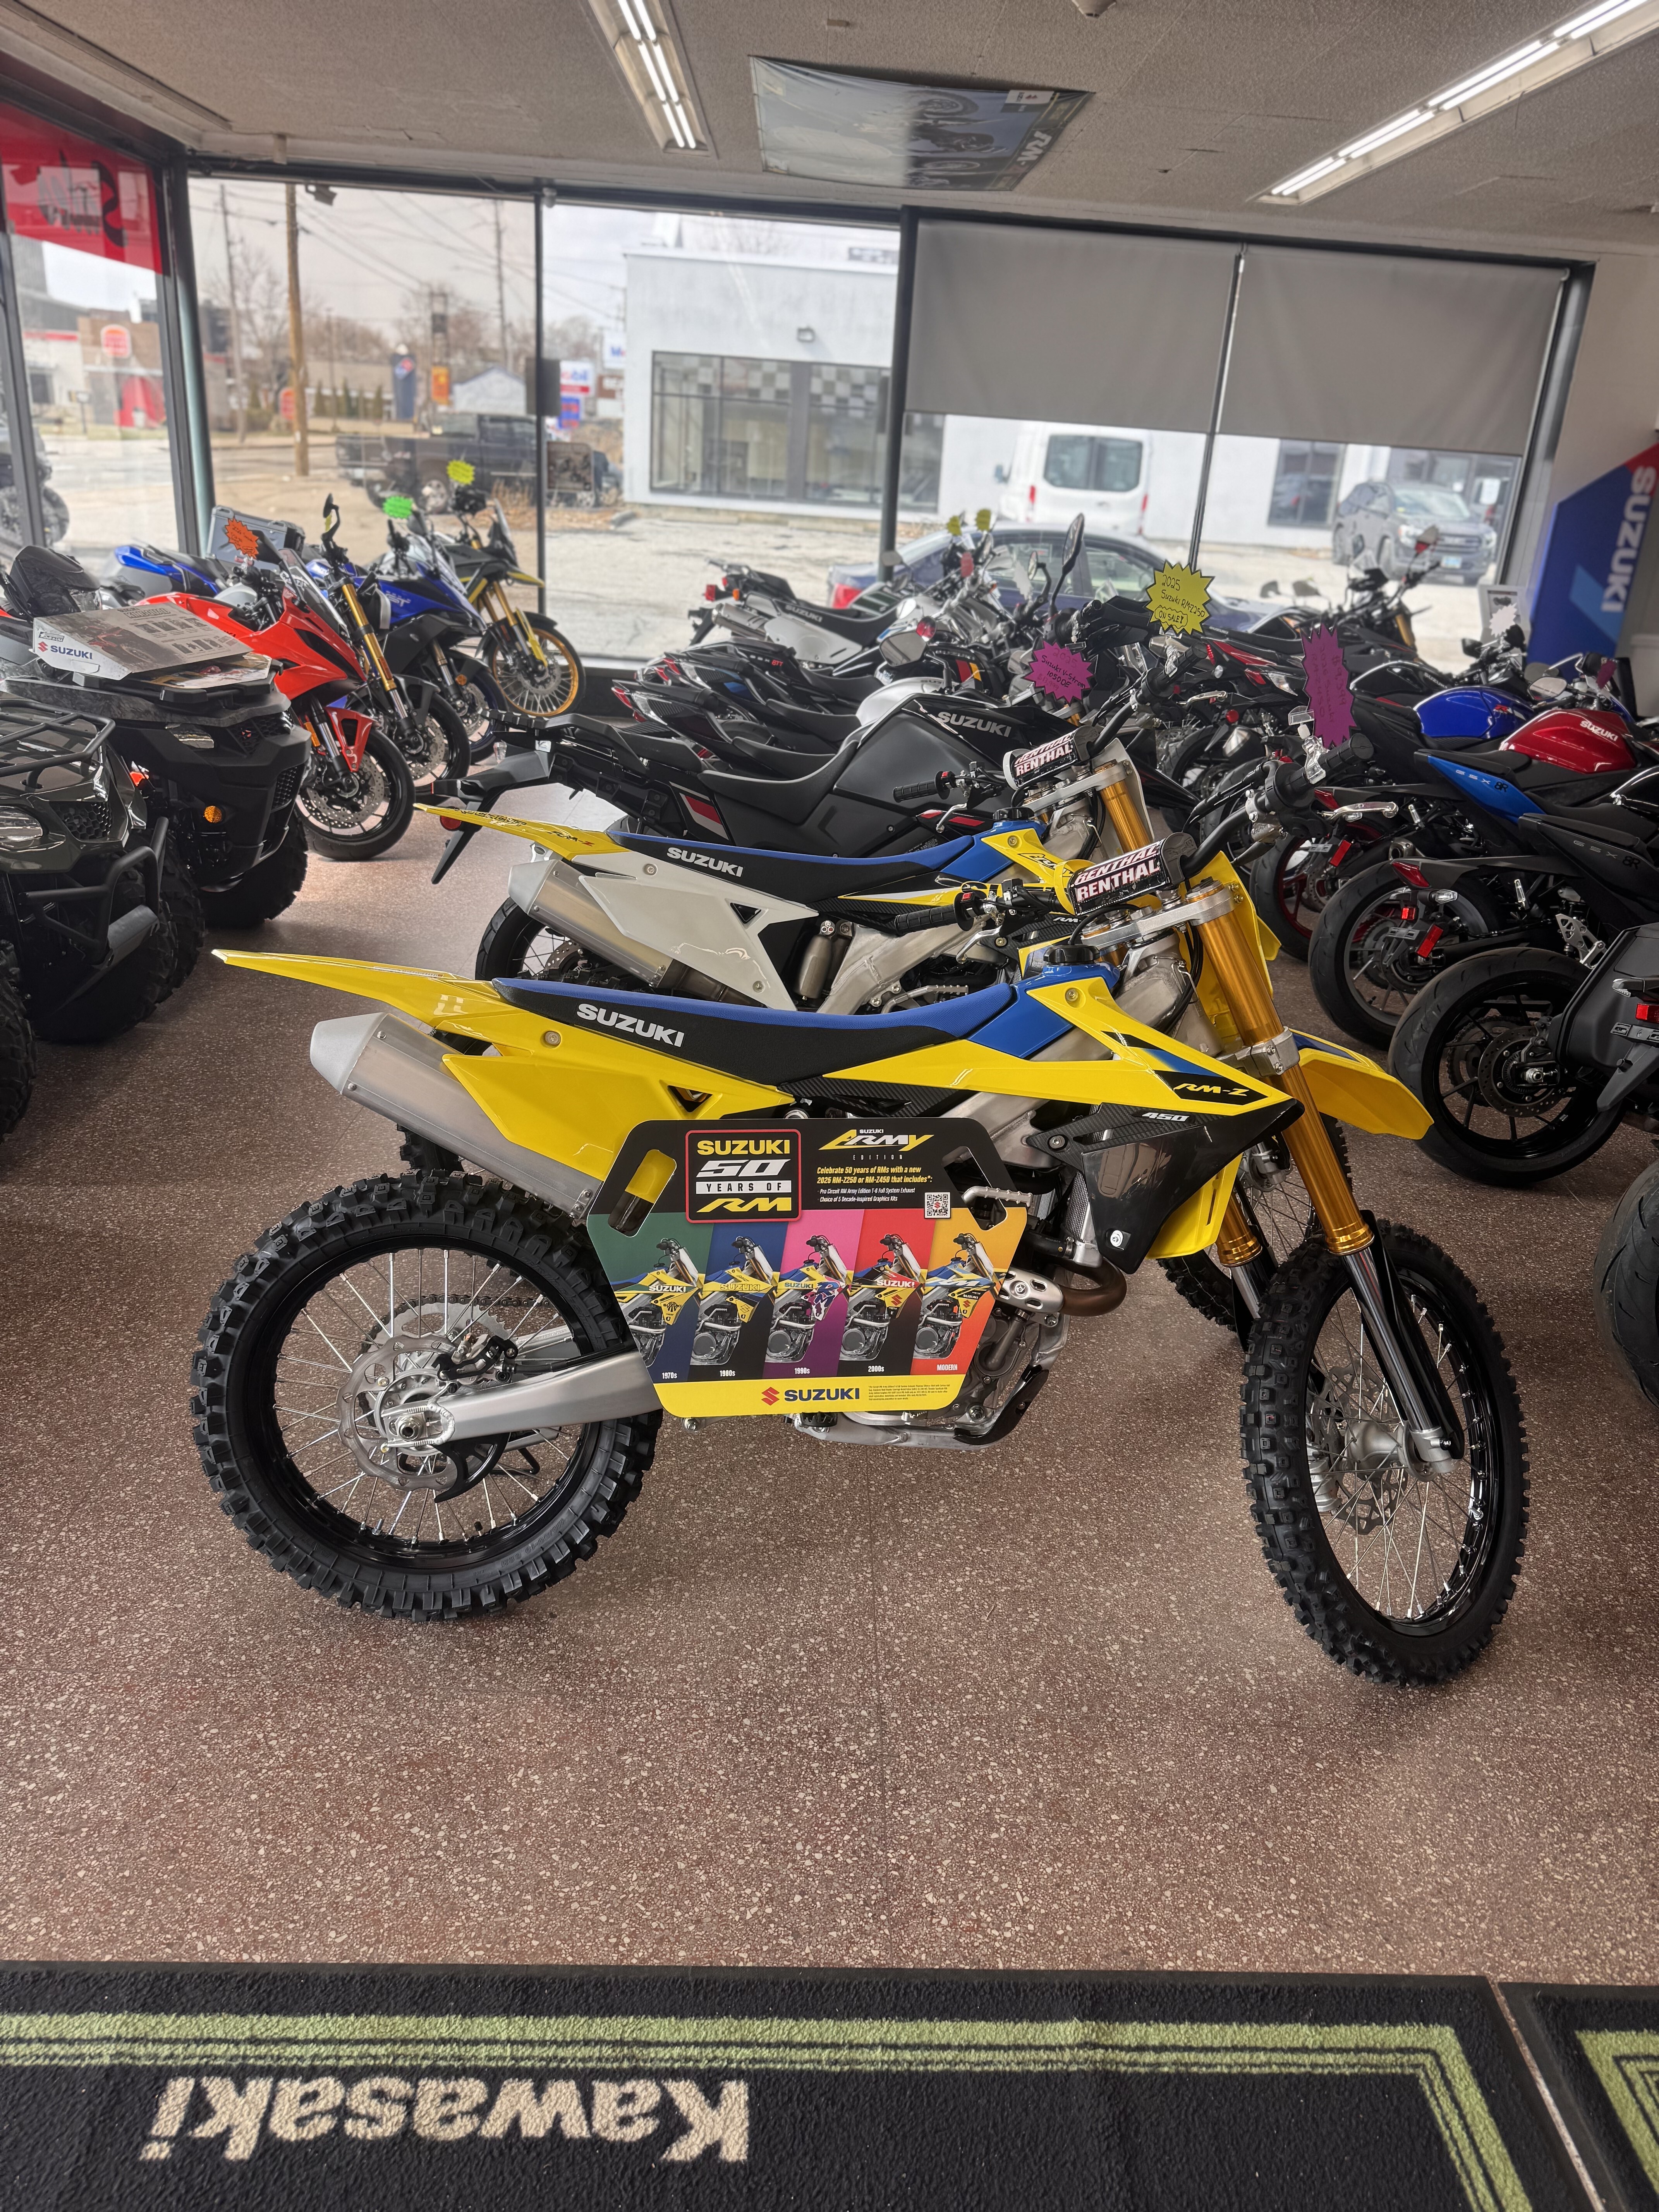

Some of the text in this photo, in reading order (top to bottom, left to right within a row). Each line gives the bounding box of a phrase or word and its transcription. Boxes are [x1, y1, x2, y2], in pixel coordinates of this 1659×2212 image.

[1601, 466, 1657, 613] SUZUKI
[1162, 574, 1180, 591] 2025
[1161, 589, 1181, 605] Suzuki
[785, 605, 823, 623] SUZUKI
[50, 645, 93, 660] SUZUKI
[1053, 648, 1078, 668] 2025
[1041, 655, 1086, 689] Suzuki V-Strom
[1424, 672, 1448, 689] SUZUKI
[937, 711, 1012, 738] SUZUKI
[1579, 720, 1619, 742] SUZUKI
[1016, 743, 1073, 777] RENTHAL
[1494, 781, 1509, 793] 8R
[666, 847, 744, 878] SUZUKI
[1573, 840, 1641, 870] GSX 8R
[1075, 859, 1160, 902] RENTHAL
[576, 1003, 685, 1048] SUZUKI
[1173, 1083, 1250, 1097] RM-Z
[1141, 1112, 1190, 1122] 450
[697, 1140, 790, 1155] SUZUKI
[696, 1159, 791, 1177] 50
[853, 1167, 869, 1175] years
[706, 1182, 781, 1192] YEARS OF
[832, 1176, 857, 1184] RM-Z250
[696, 1197, 792, 1212] RM
[876, 1280, 915, 1288] SUZUKI
[784, 1388, 860, 1402] SUZUKI
[139, 2076, 750, 2163] Kawasaki
